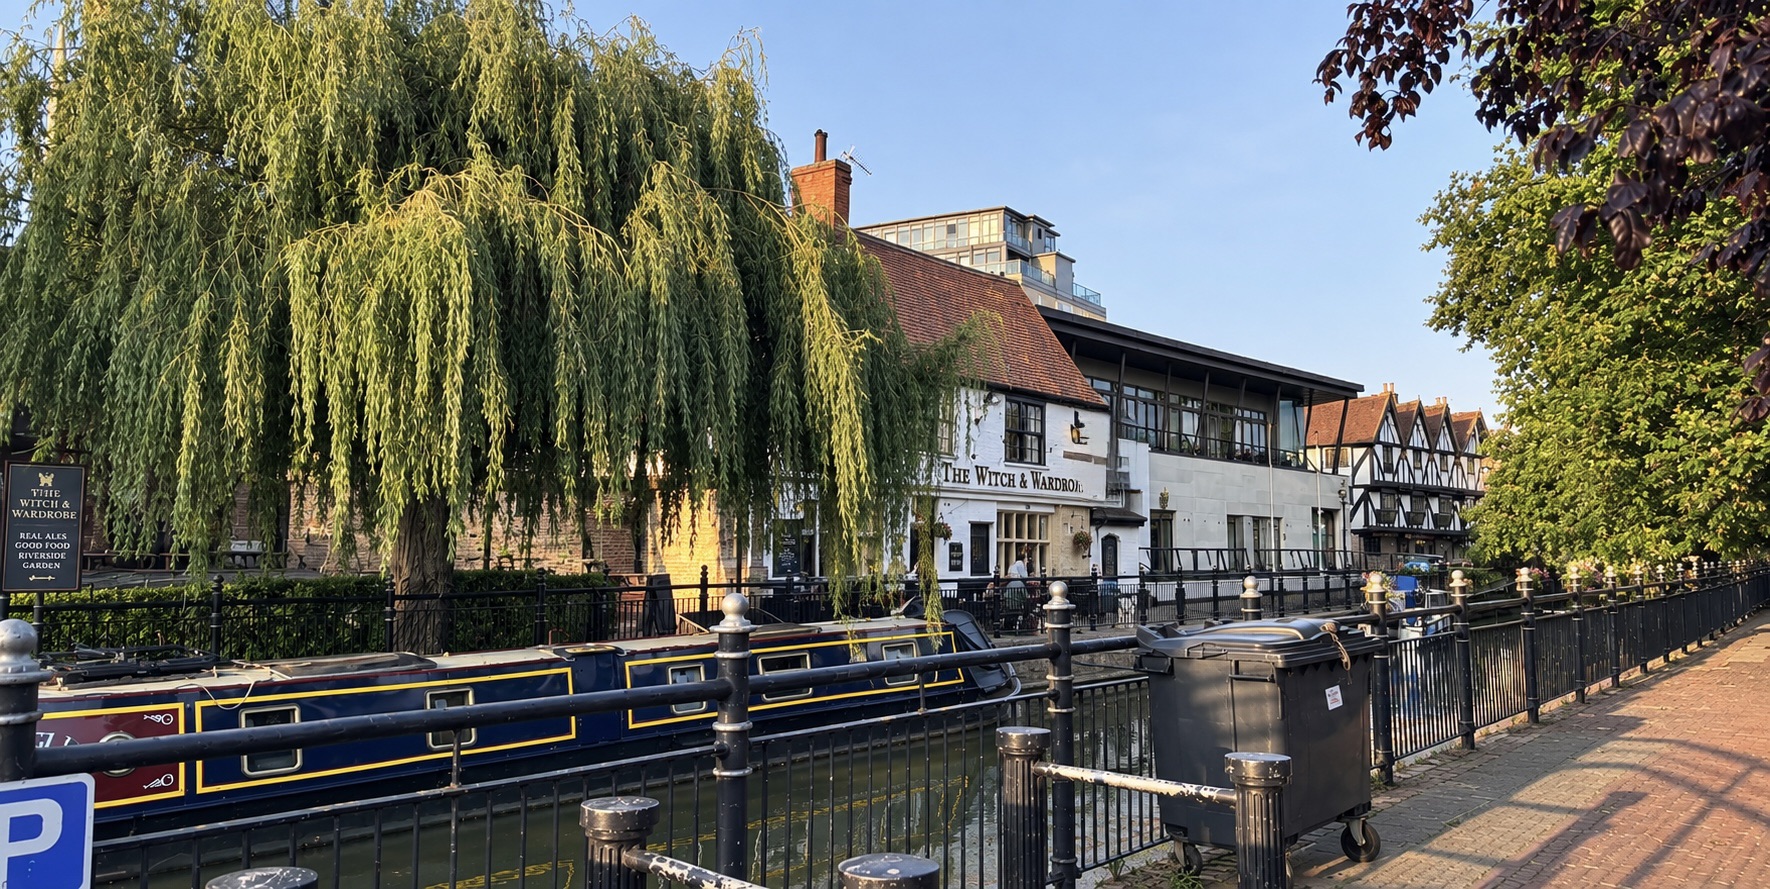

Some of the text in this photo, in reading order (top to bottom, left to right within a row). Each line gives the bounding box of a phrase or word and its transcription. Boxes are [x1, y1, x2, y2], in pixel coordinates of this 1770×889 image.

[942, 462, 970, 484] THE
[975, 465, 1016, 488] WITCH
[1019, 473, 1028, 489] &
[20, 499, 70, 509] WITCH &
[12, 509, 77, 519] WARDROBE
[19, 532, 67, 540] REAL ALES
[0, 798, 63, 889] P
